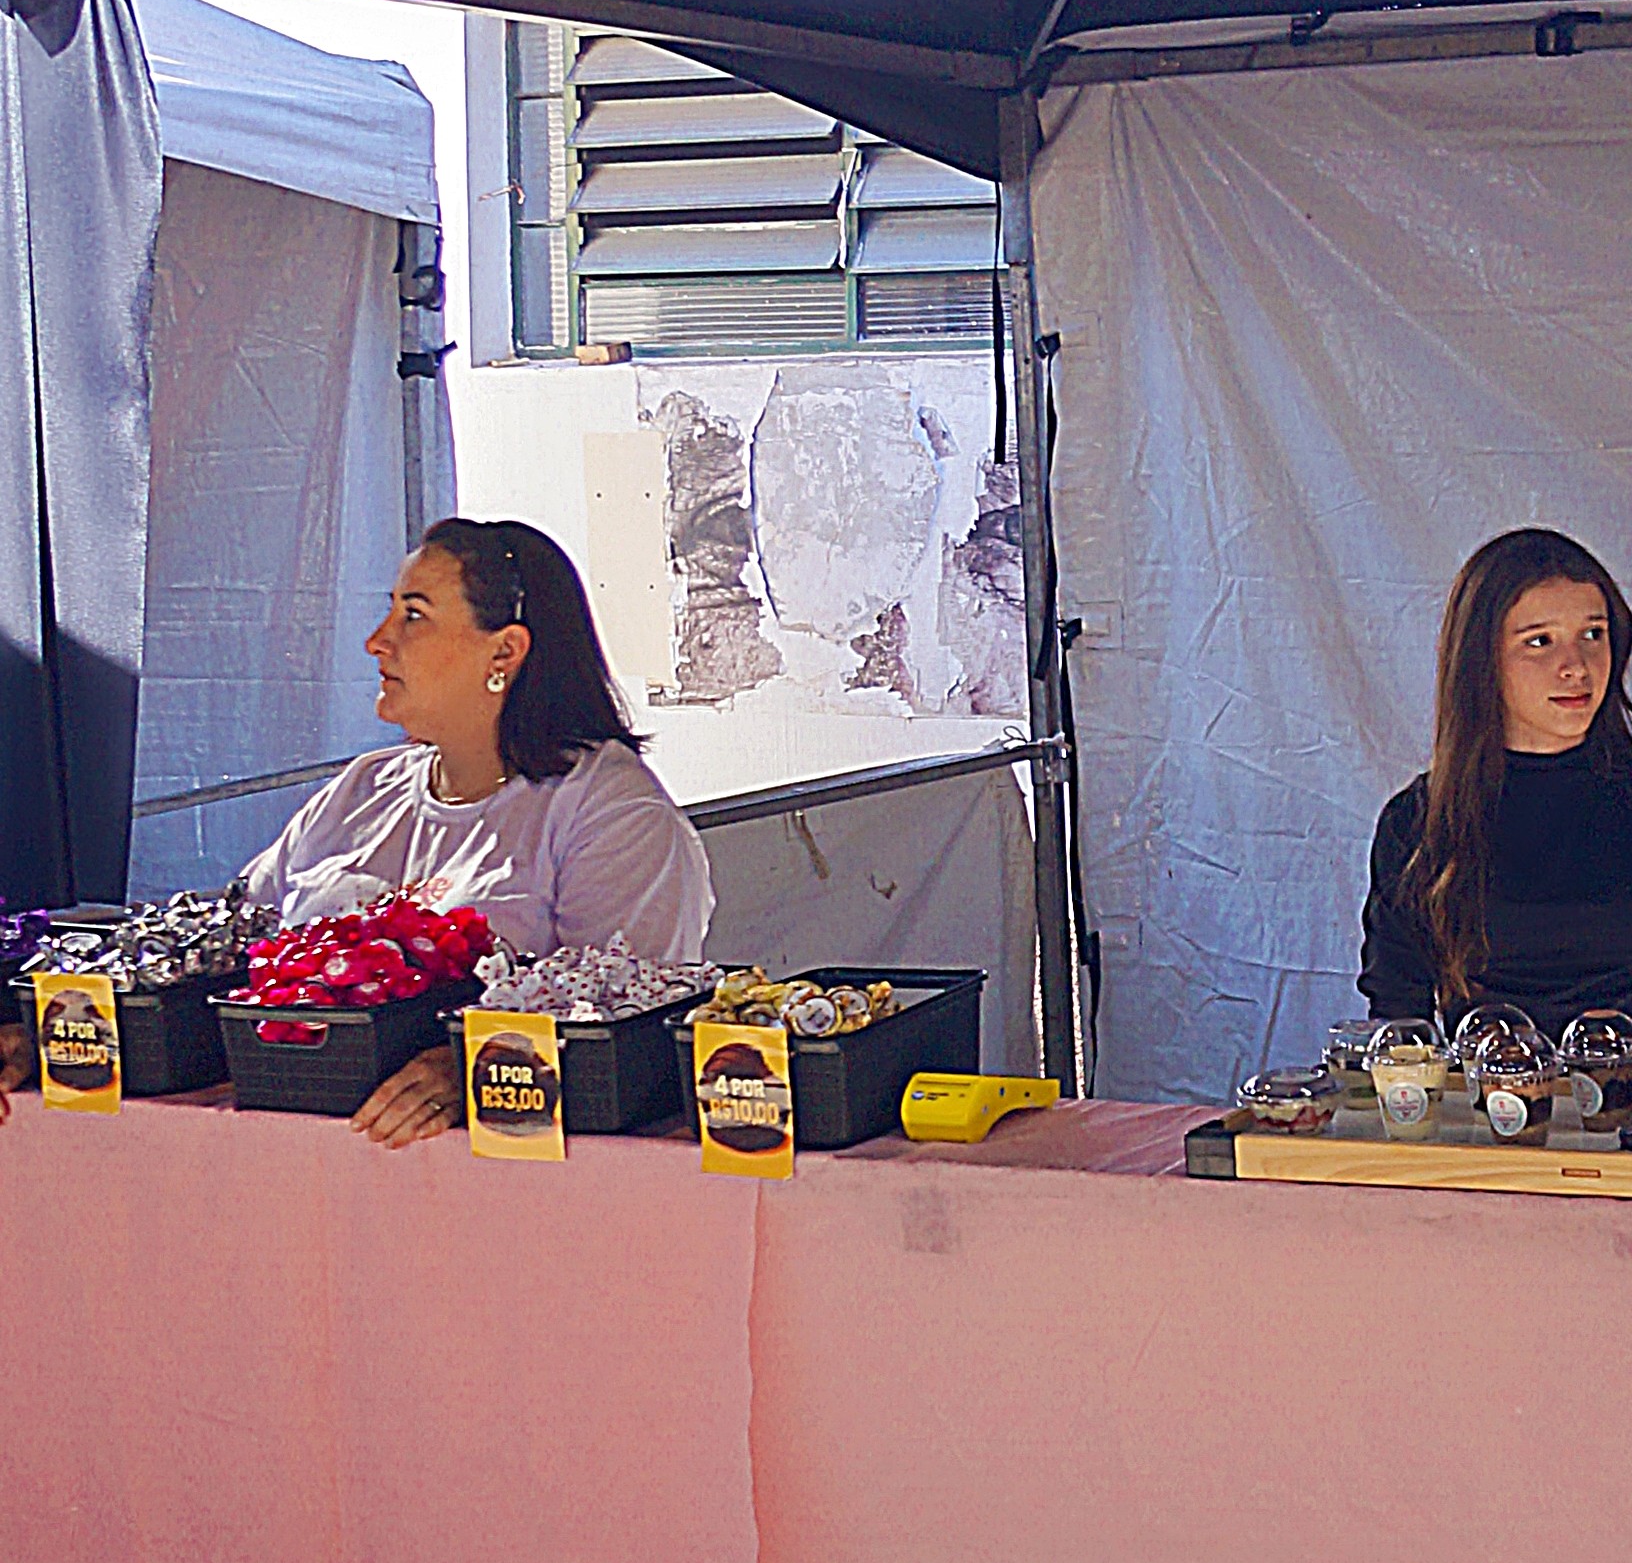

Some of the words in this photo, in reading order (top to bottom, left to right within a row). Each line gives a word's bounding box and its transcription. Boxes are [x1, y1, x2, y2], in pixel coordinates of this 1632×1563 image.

[53, 1018, 66, 1038] 4
[67, 1021, 97, 1040] POR
[487, 1063, 499, 1084] 1
[500, 1065, 534, 1085] POR
[714, 1074, 729, 1096] 4
[730, 1078, 767, 1098] POR
[481, 1085, 546, 1113] R$3,00
[709, 1098, 780, 1126] R$10,00
